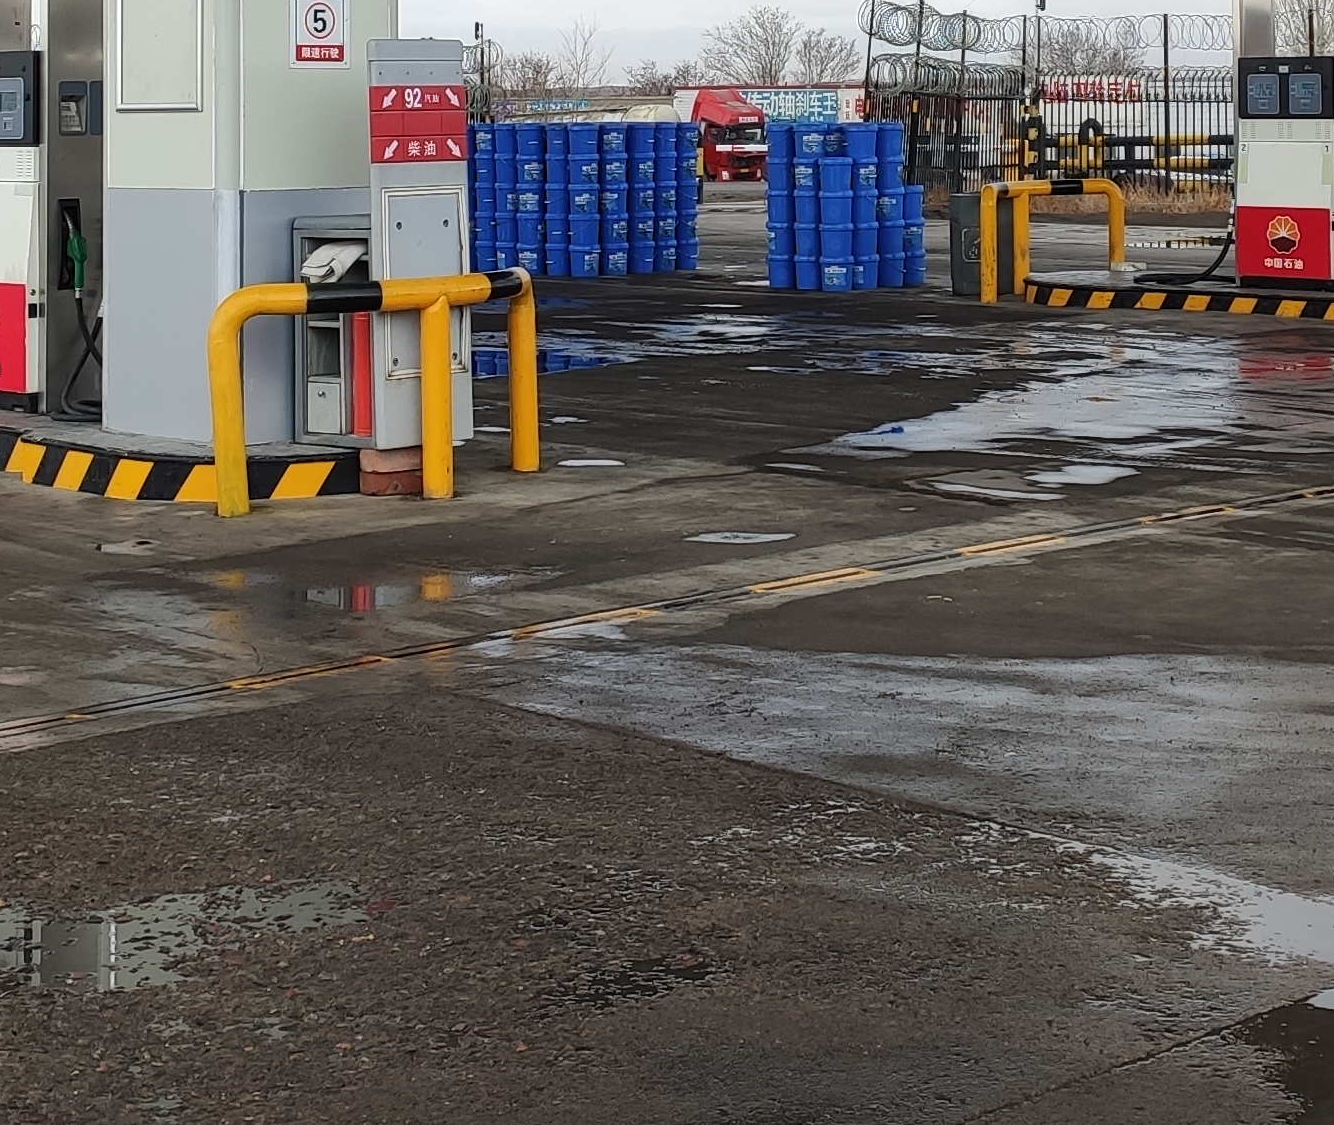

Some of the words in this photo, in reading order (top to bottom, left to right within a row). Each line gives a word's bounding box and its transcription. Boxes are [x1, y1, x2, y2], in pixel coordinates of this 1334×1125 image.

[313, 9, 327, 34] 5
[404, 88, 422, 109] 92
[407, 140, 437, 158] 柴油
[1241, 143, 1247, 152] 2
[1264, 257, 1303, 270] 中国石油
